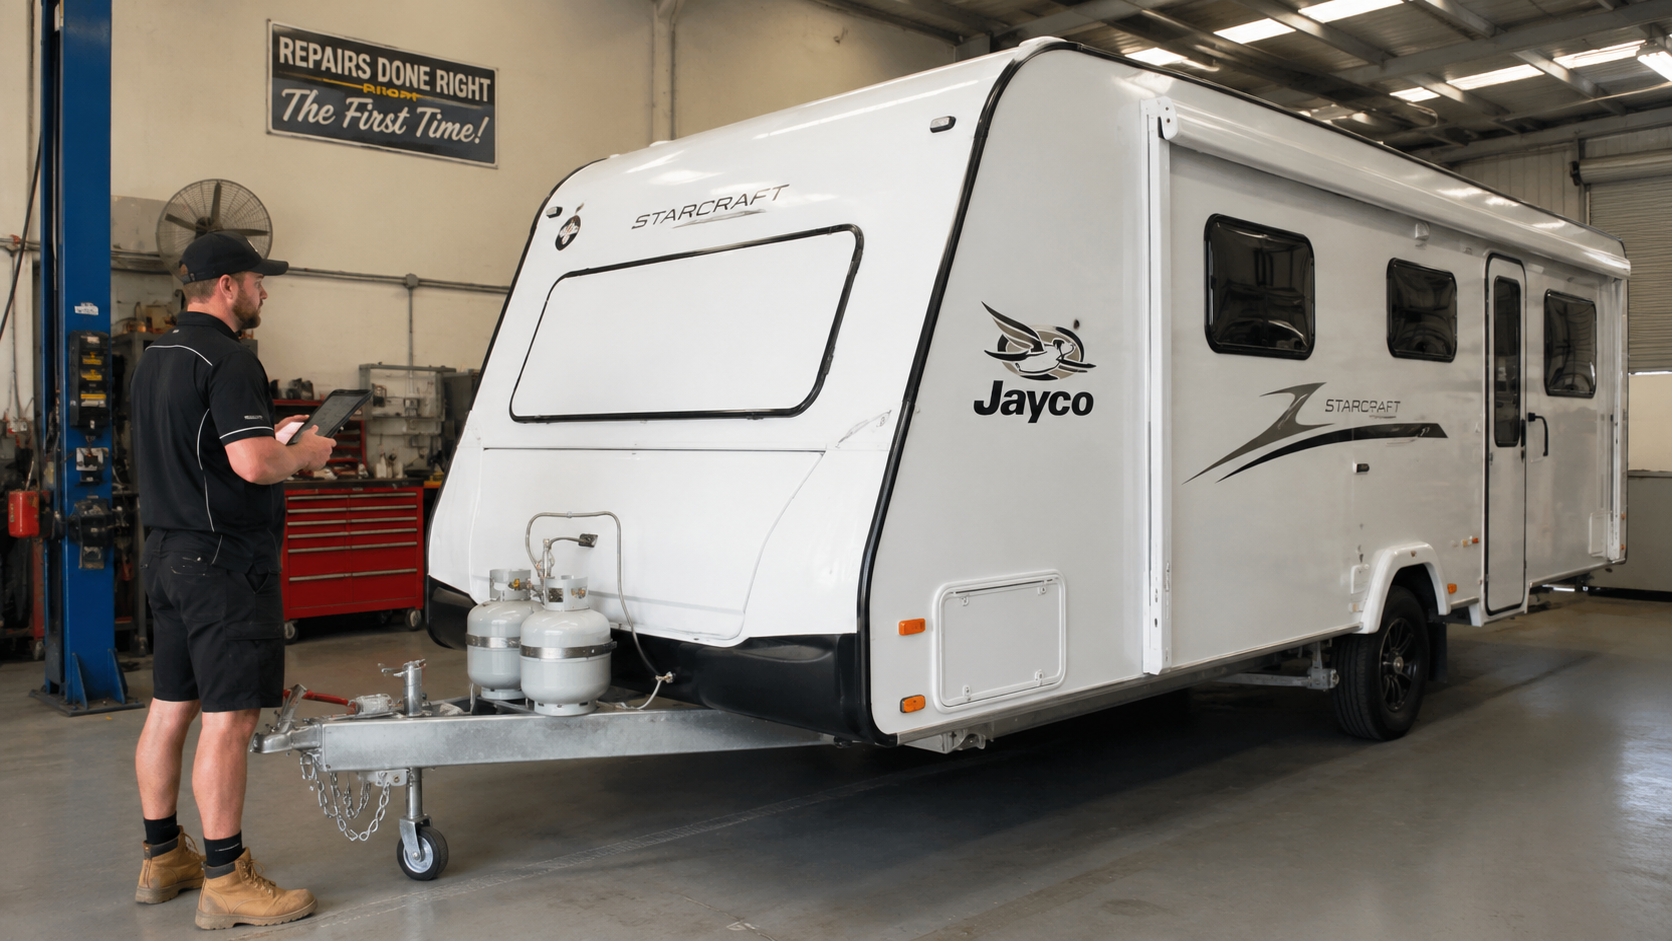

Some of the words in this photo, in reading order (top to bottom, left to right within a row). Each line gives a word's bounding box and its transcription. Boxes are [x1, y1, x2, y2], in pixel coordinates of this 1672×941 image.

[278, 36, 371, 80] REPAIRS
[377, 56, 431, 91] DONE
[436, 69, 492, 102] RIGHT
[281, 88, 336, 125] The
[342, 97, 411, 135] First
[415, 106, 490, 144] Time!
[631, 183, 790, 230] STARCRAFT
[973, 380, 1094, 424] Jayco
[1324, 398, 1401, 413] STARCRAFT
